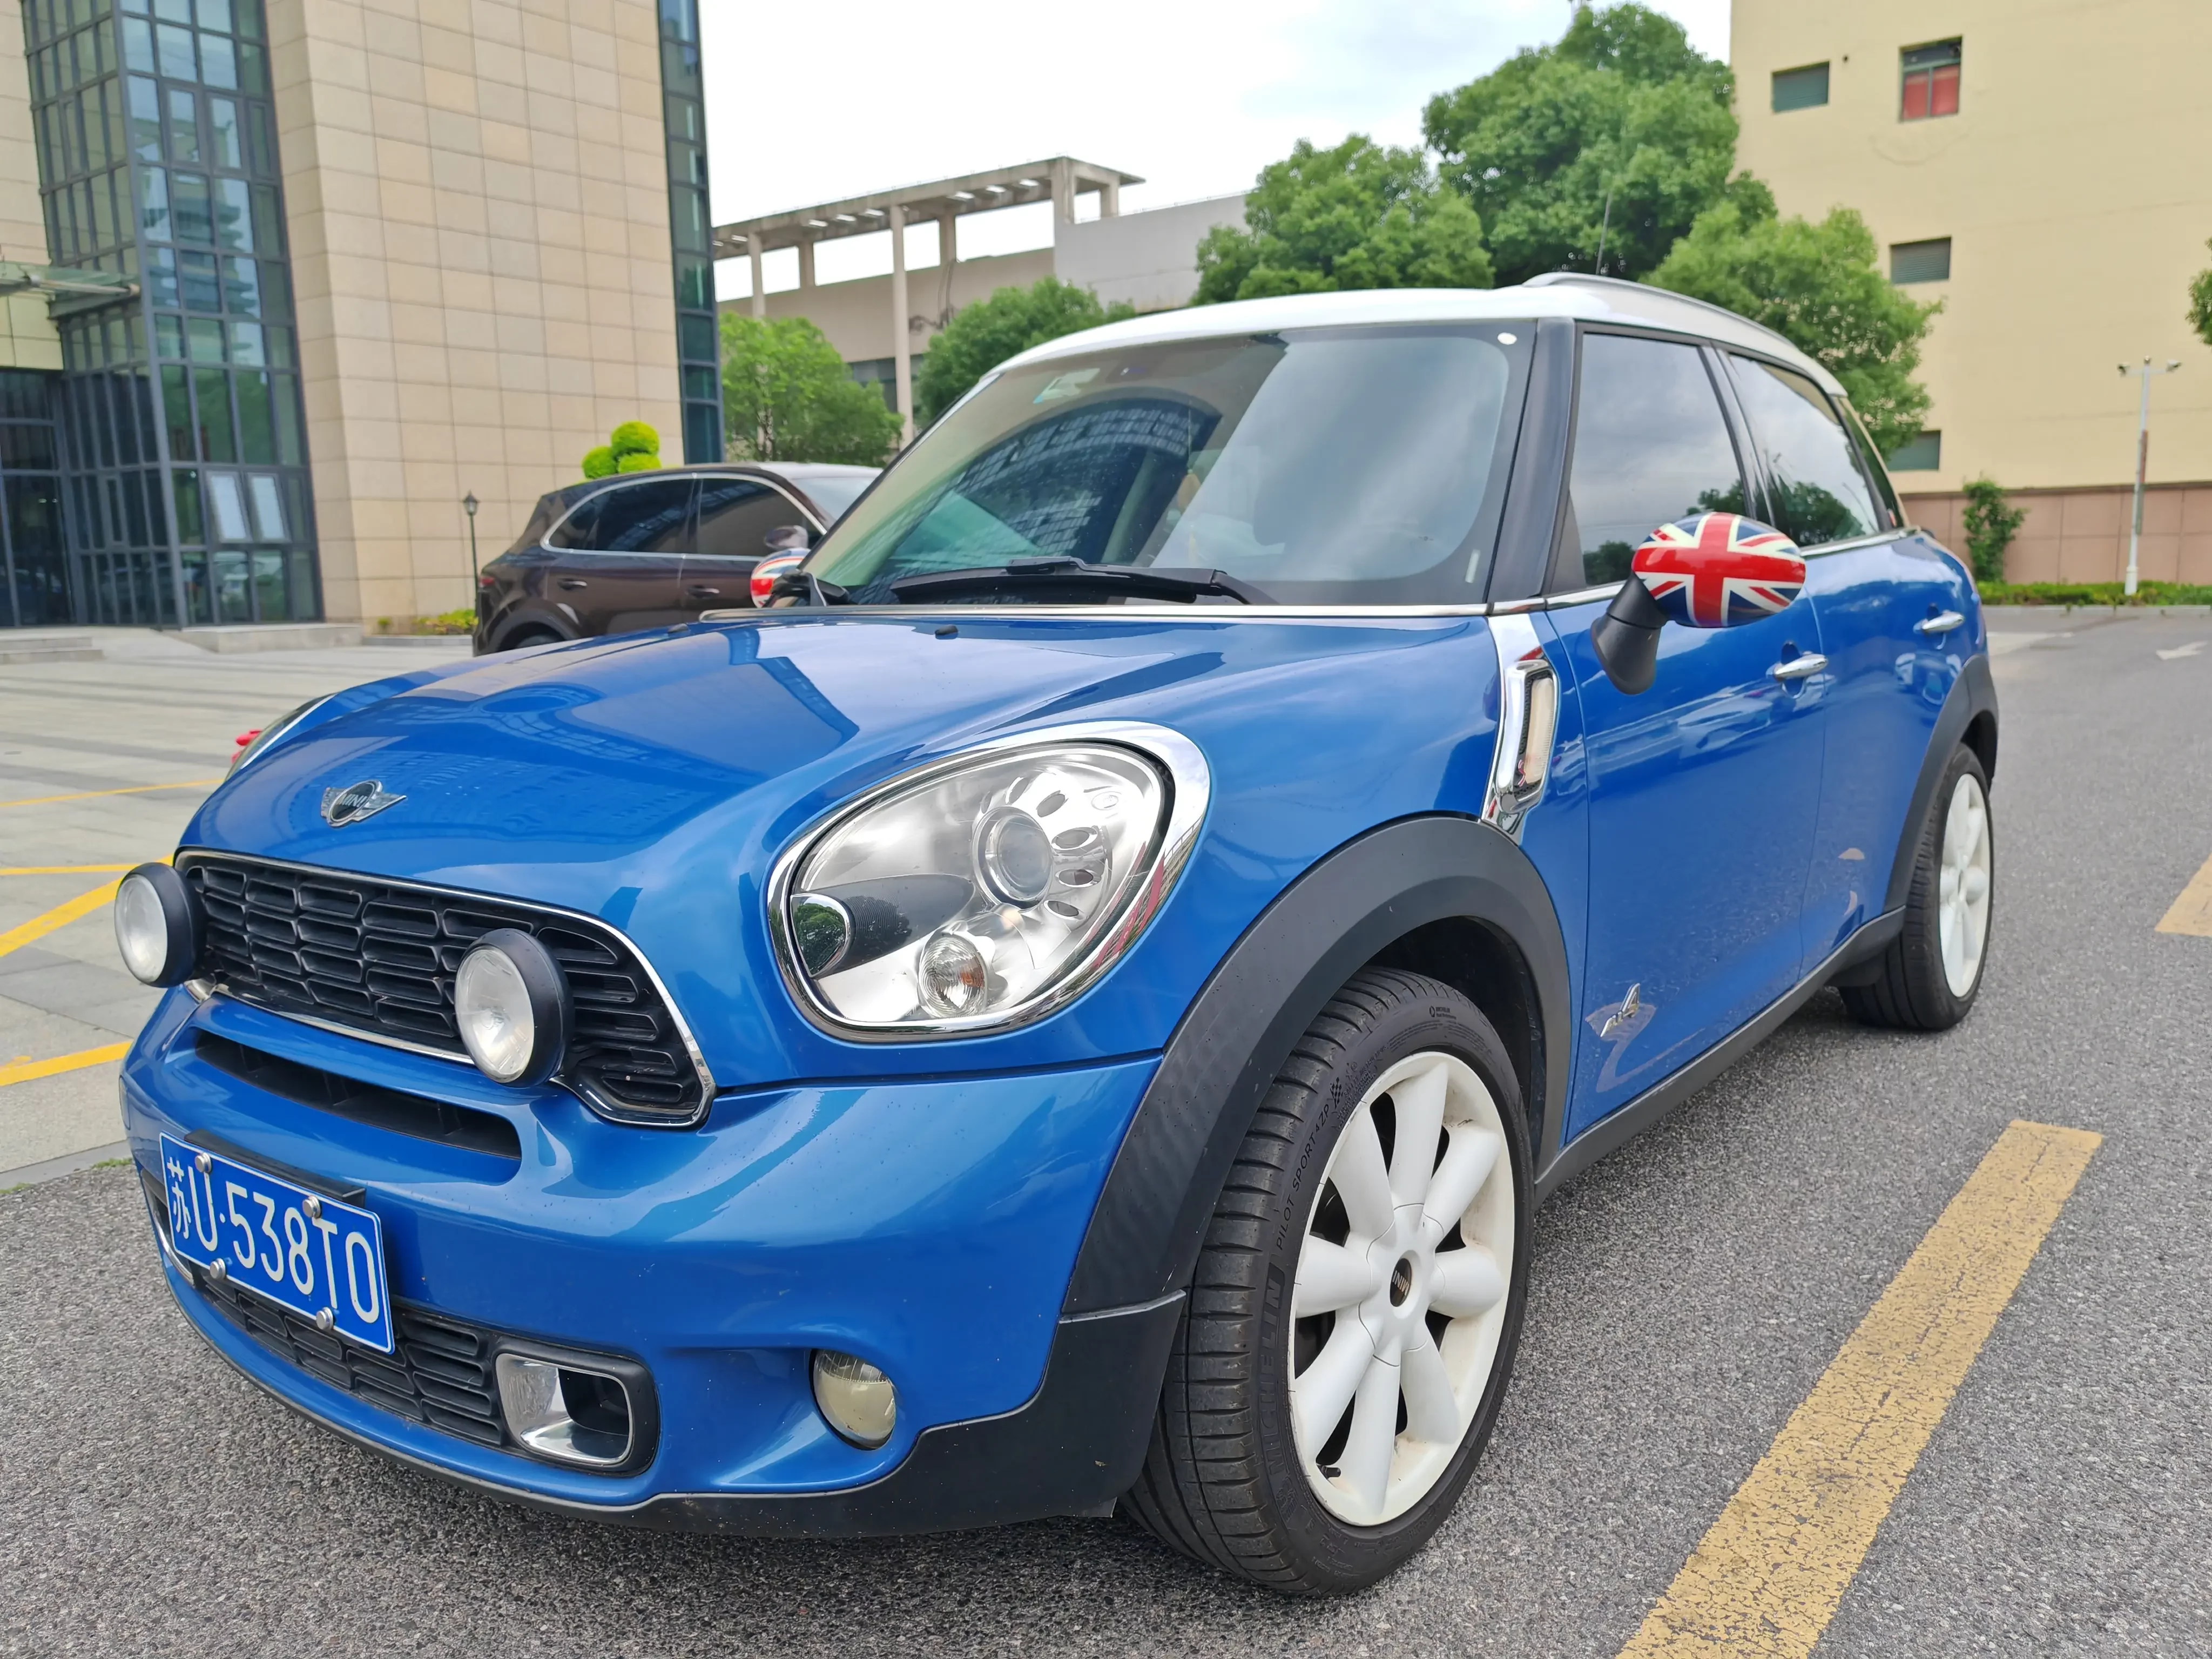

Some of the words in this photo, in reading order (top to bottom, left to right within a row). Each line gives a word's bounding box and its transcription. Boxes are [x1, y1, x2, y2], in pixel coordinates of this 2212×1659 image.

[338, 793, 368, 807] MINI
[1276, 1194, 1296, 1250] PILOT
[1292, 1131, 1317, 1192] SPORT
[1392, 1270, 1410, 1297] MINI
[1260, 1278, 1285, 1476] MICHELIN
